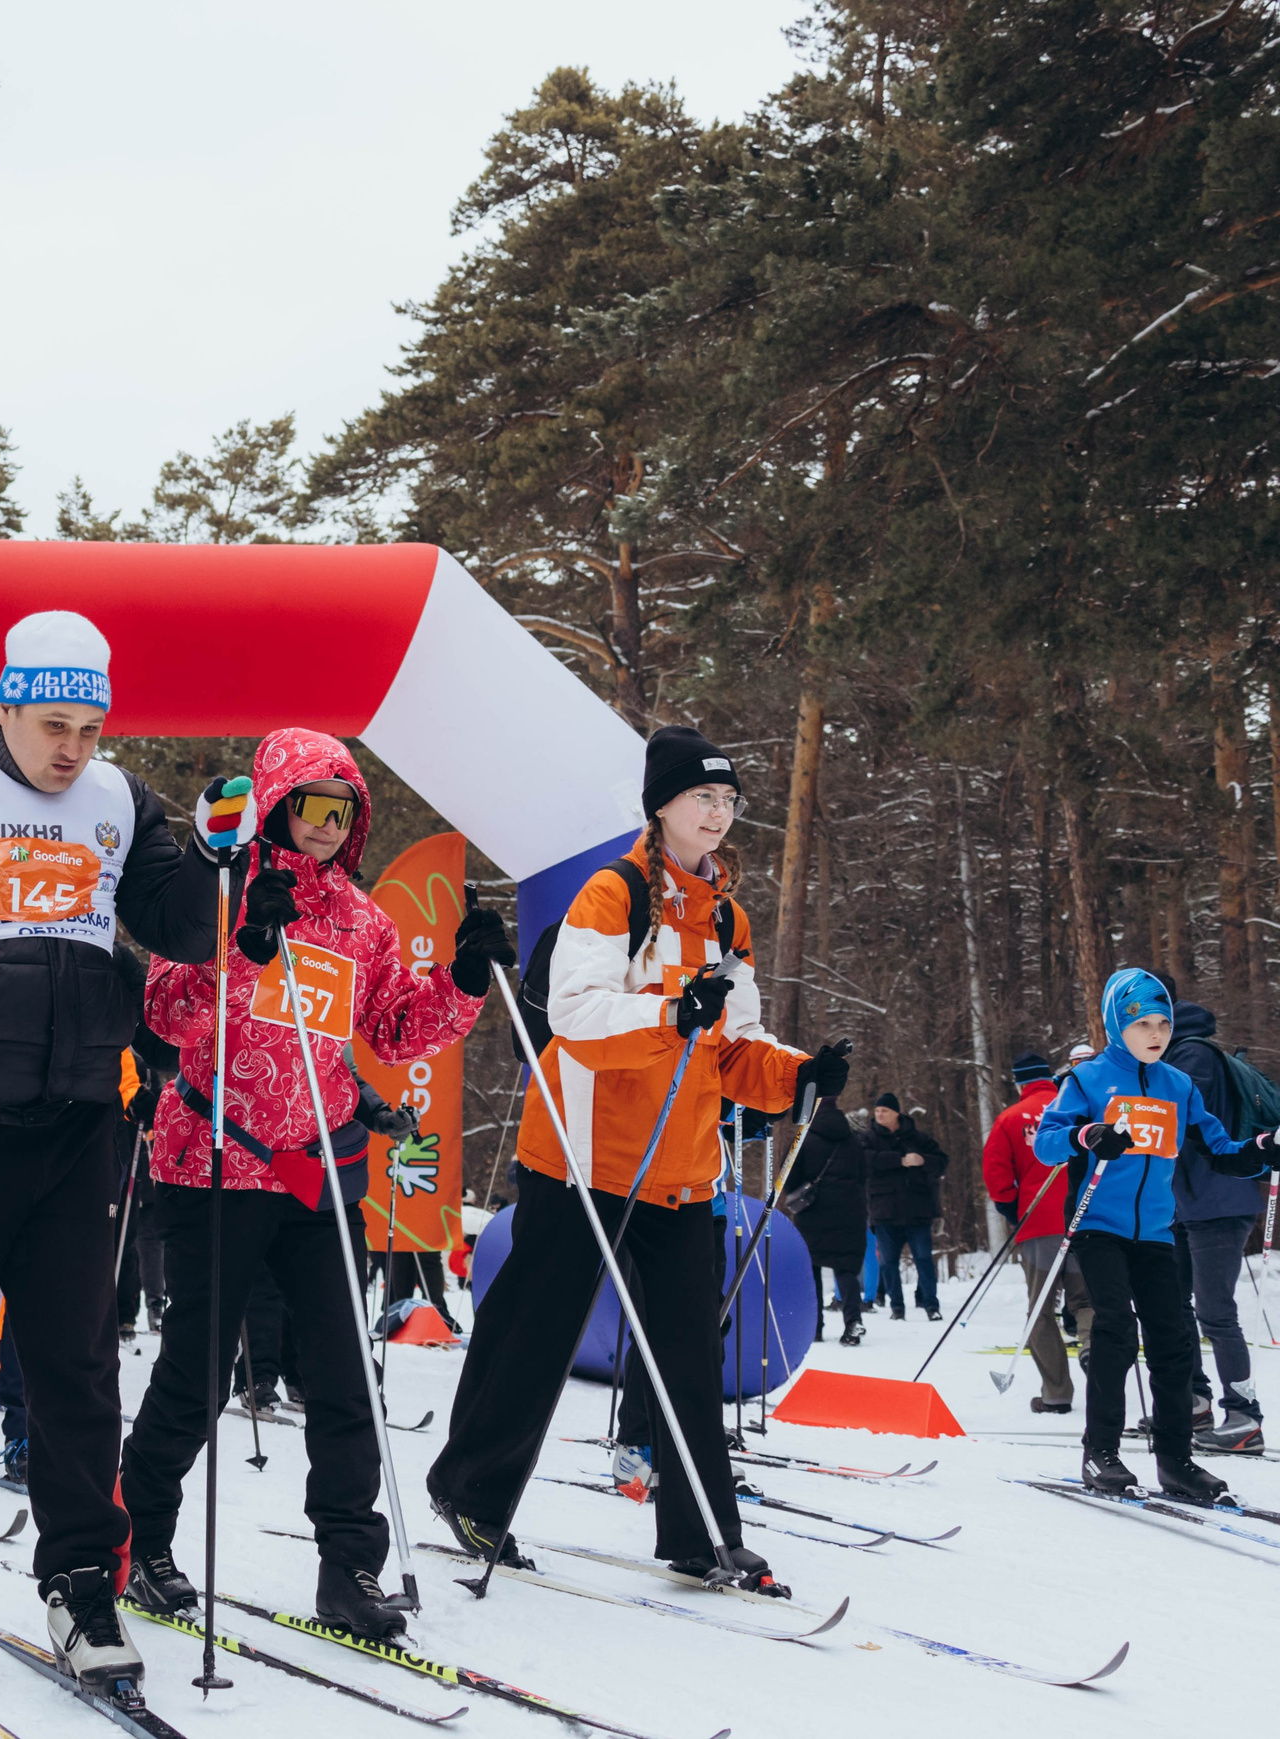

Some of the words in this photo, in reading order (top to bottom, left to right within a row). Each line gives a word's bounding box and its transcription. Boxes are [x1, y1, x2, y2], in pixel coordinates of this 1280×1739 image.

[32, 671, 108, 690] ЛЫЖНЯ
[33, 850, 83, 867] Goodline
[8, 877, 79, 913] 145
[301, 956, 339, 977] Goodline
[279, 979, 334, 1023] 157
[1134, 1103, 1167, 1115] Goodline
[1213, 1504, 1244, 1516] CLASSIC
